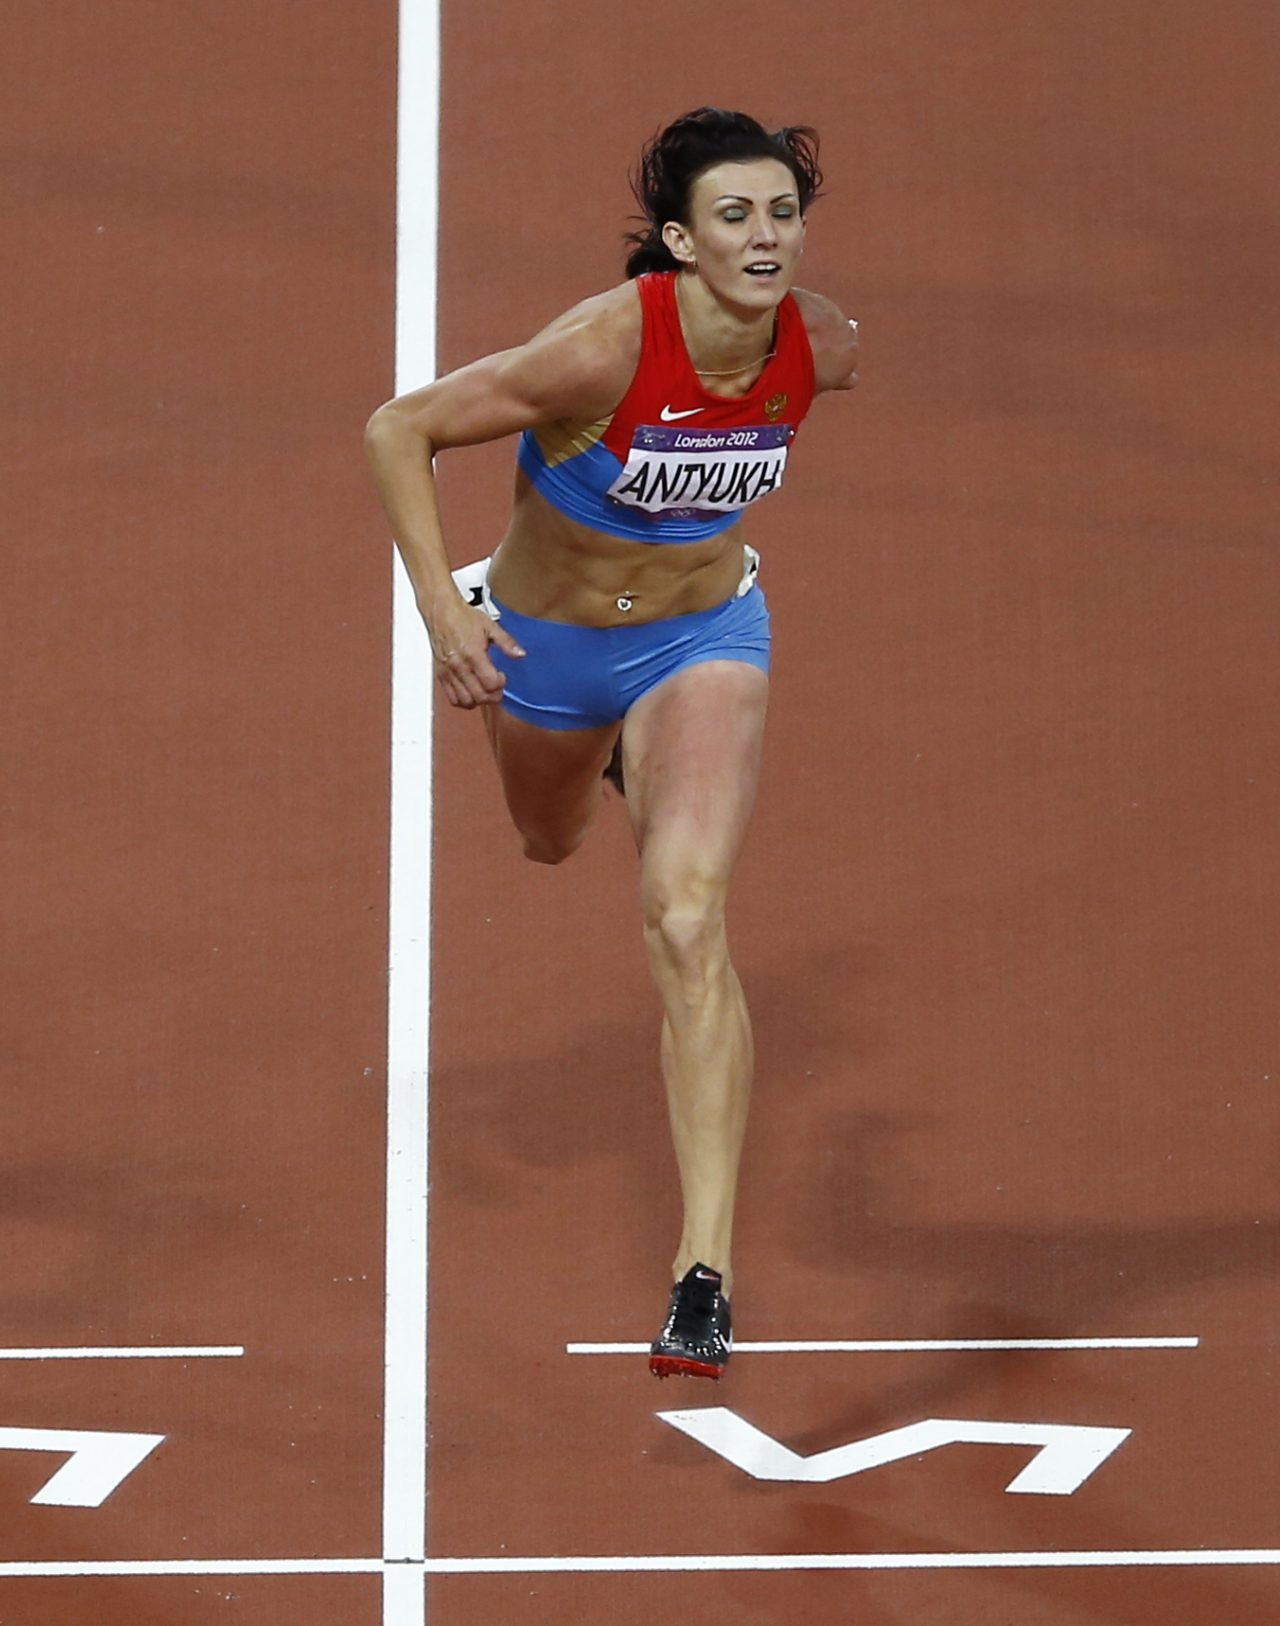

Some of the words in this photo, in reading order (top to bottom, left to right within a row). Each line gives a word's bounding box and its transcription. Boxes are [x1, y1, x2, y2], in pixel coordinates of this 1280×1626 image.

[674, 433, 725, 449] London
[726, 431, 759, 446] 2012
[617, 459, 782, 504] ANTYUKH
[655, 1406, 1132, 1495] 5
